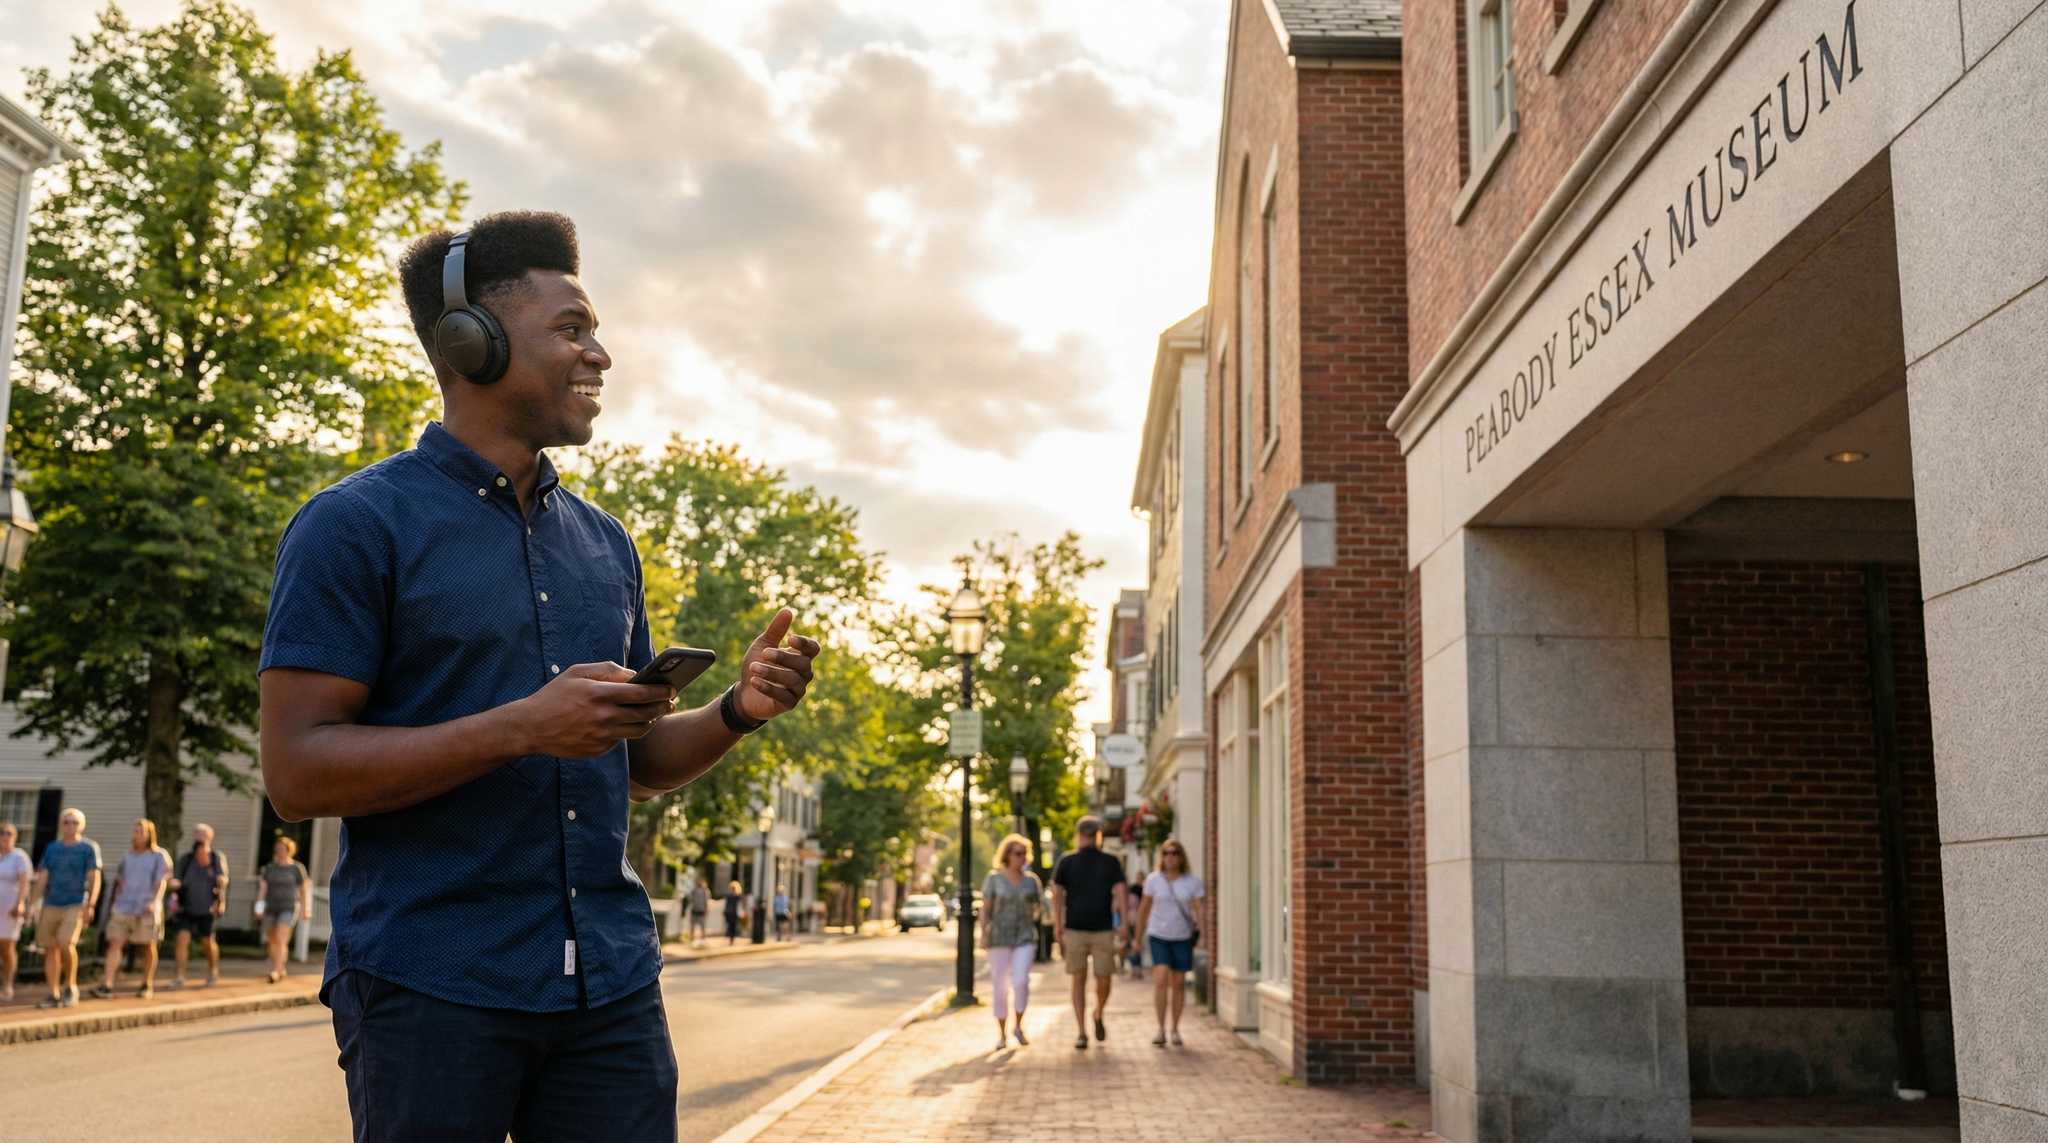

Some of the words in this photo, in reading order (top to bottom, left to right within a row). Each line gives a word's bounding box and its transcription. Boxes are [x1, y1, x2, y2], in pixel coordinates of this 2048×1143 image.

[1465, 332, 1558, 474] PEABODY
[1567, 227, 1655, 370] ESSEX
[1666, 0, 1864, 268] MUSEUM
